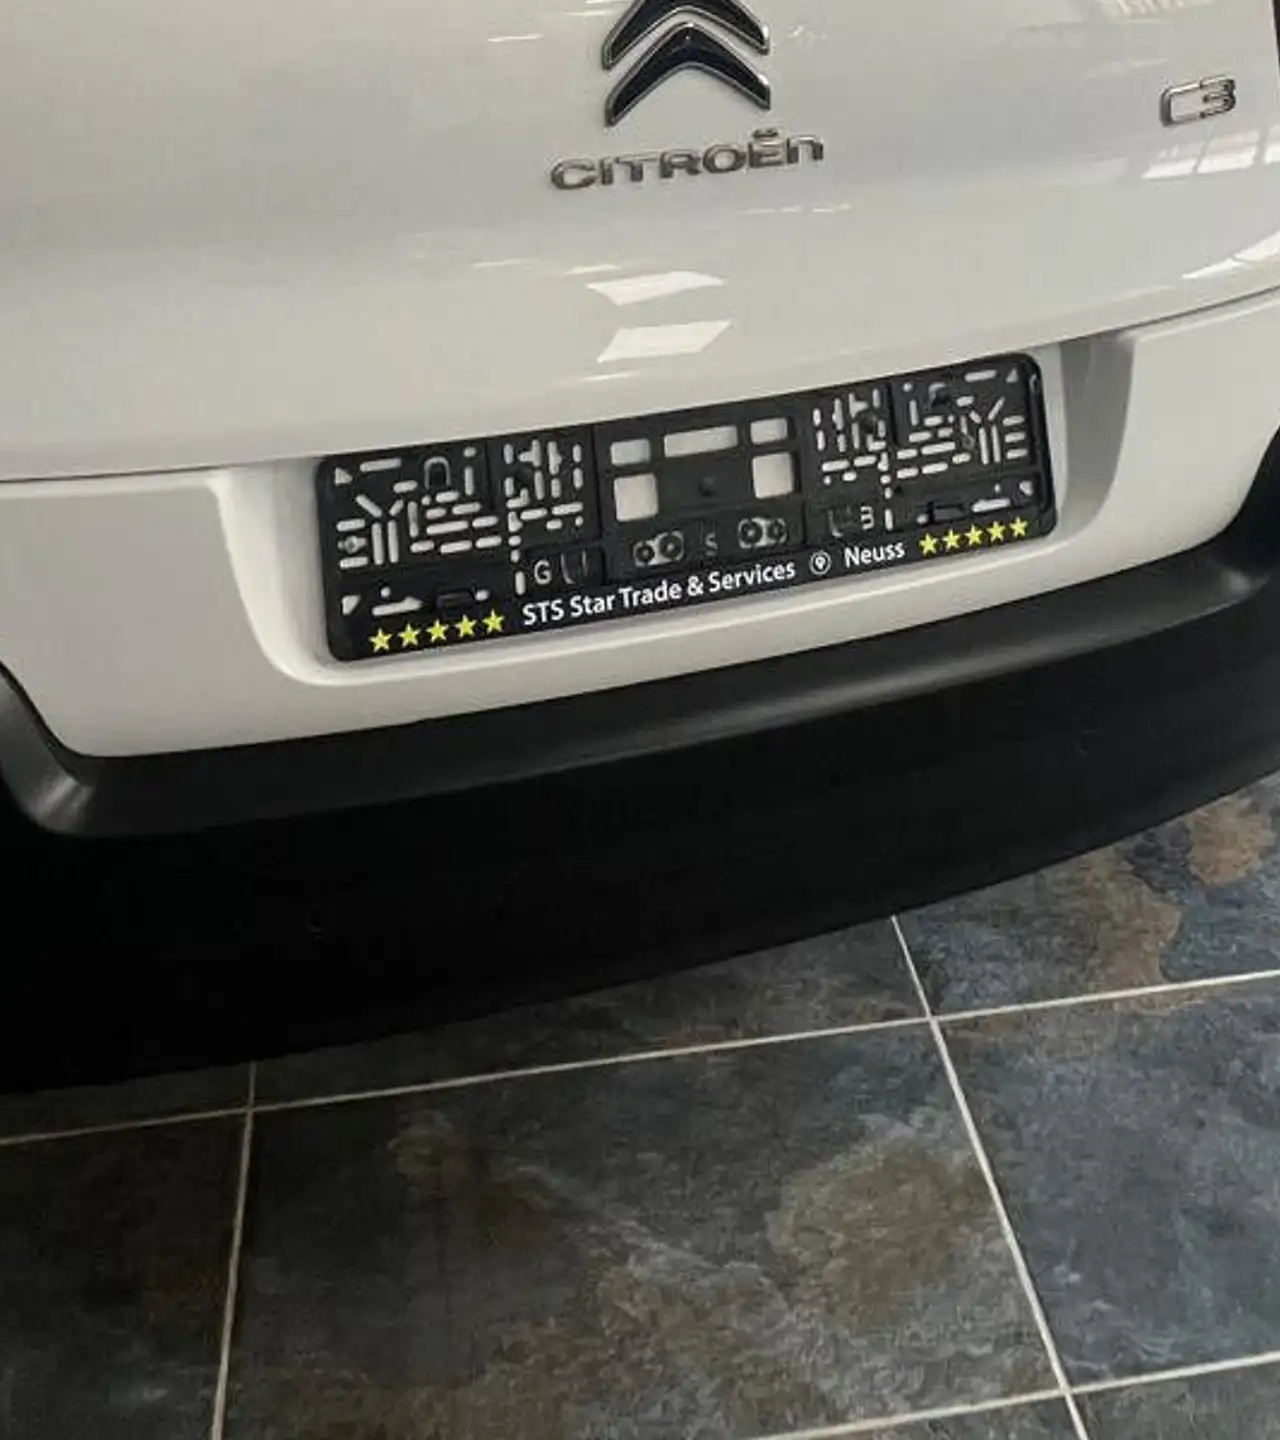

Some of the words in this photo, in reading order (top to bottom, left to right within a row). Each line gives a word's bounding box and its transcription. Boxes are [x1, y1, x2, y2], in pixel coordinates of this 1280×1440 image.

[1160, 75, 1237, 126] C3
[844, 540, 905, 568] Neuss
[522, 598, 565, 627] STS
[569, 591, 615, 618] Star
[618, 577, 682, 607] Trade
[686, 575, 706, 596] &
[708, 559, 796, 590] Services
